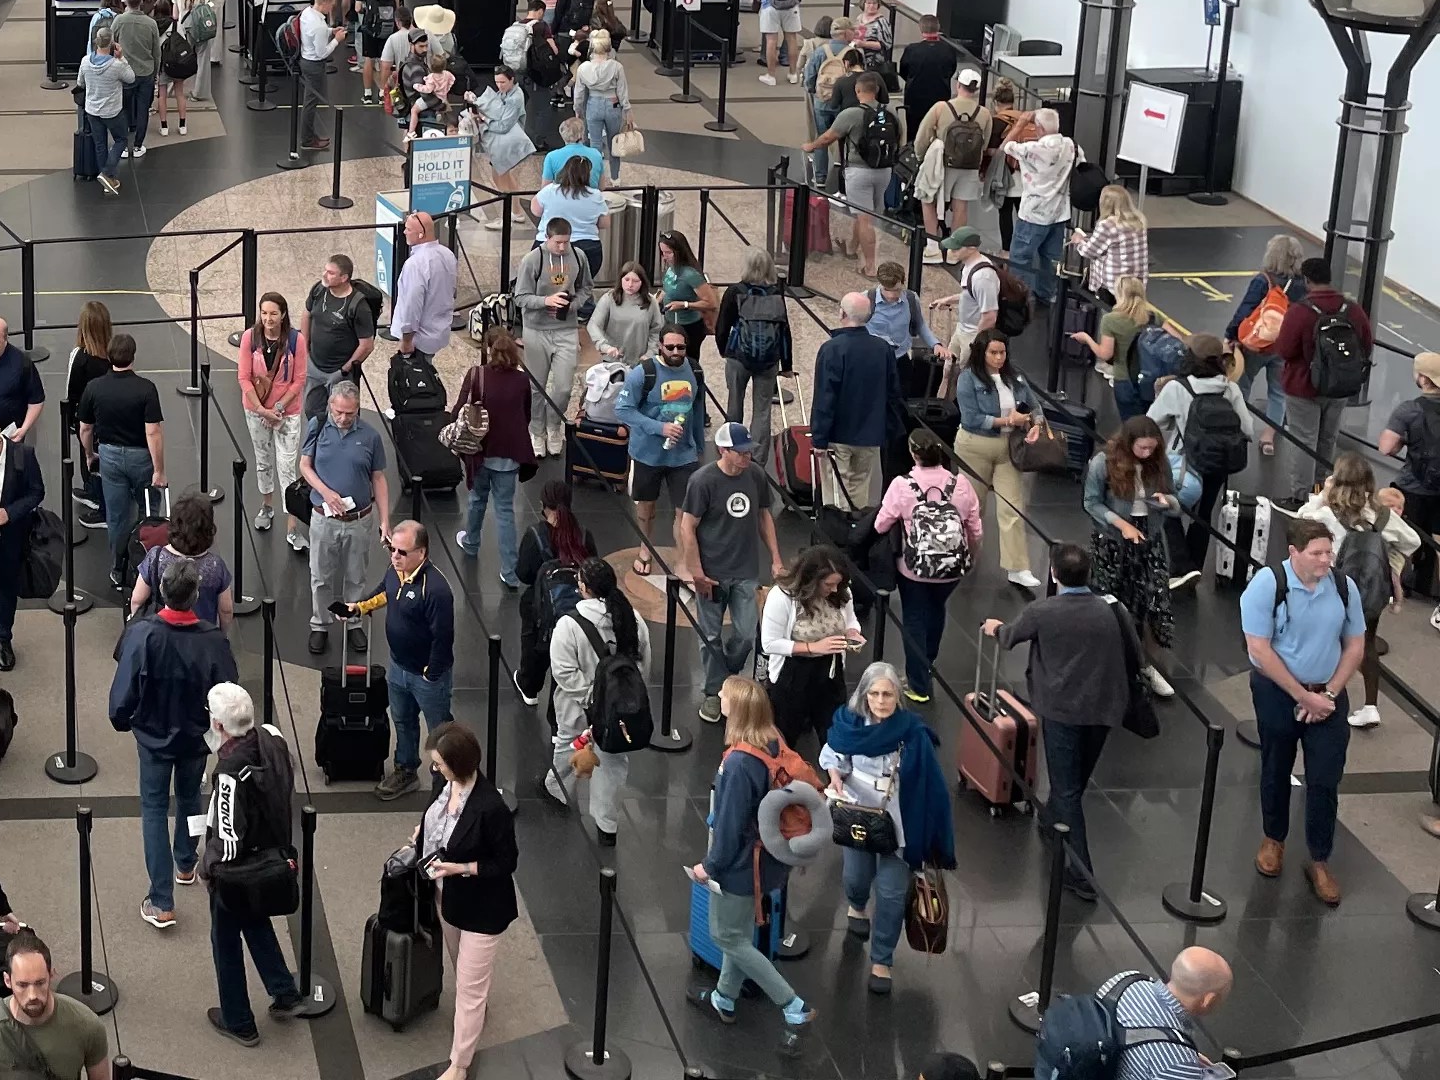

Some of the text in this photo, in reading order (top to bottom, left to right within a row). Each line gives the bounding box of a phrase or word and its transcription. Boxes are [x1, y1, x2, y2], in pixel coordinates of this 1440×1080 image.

[417, 149, 465, 162] EMPTY IT
[417, 159, 464, 172] HOLD IT
[417, 169, 464, 182] REFILL IT
[220, 782, 234, 838] ADIDAS
